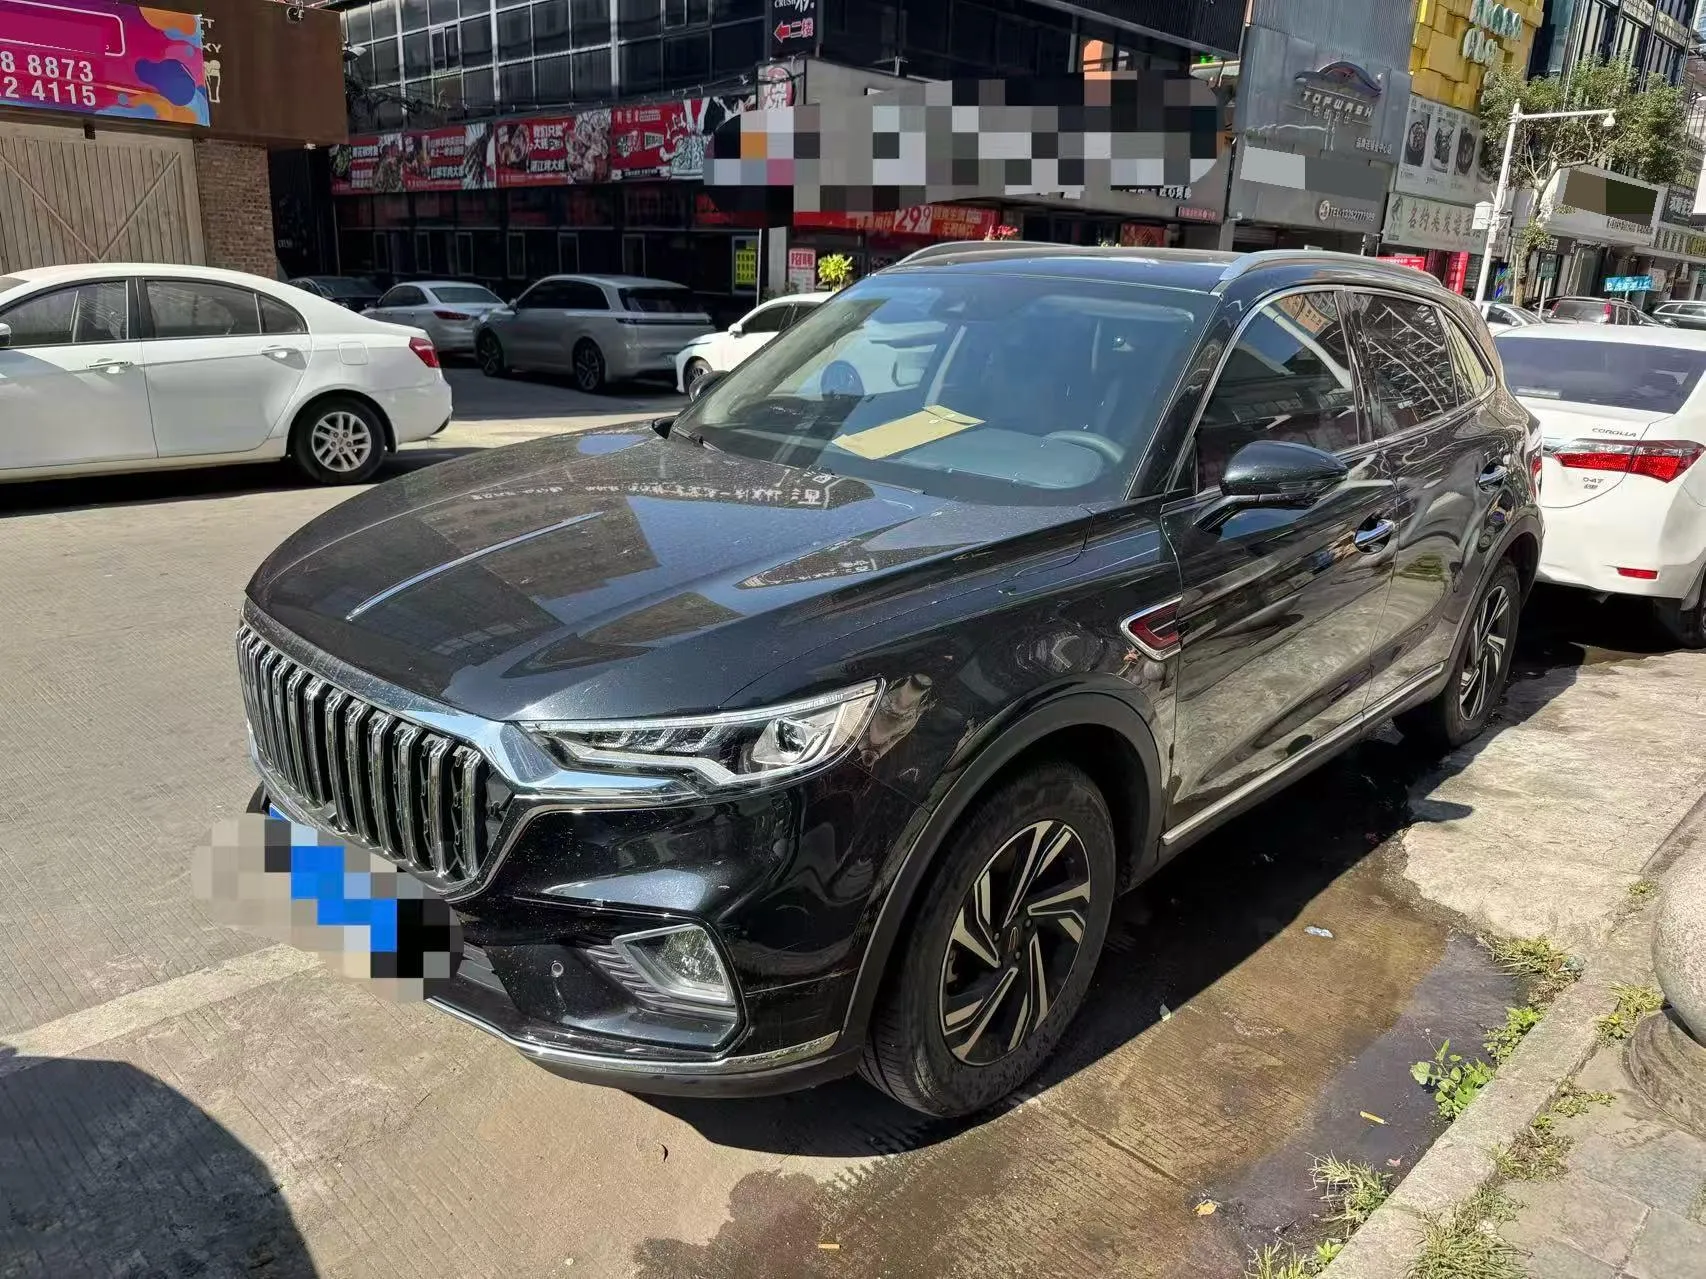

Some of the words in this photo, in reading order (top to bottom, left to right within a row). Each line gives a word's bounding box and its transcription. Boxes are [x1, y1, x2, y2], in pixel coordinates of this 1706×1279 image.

[790, 17, 814, 38] 二楼
[0, 51, 16, 73] 8
[27, 54, 94, 83] 8873
[0, 76, 20, 98] 2
[31, 79, 96, 107] 4115
[1303, 90, 1374, 118] TOPWASH
[1592, 427, 1637, 438] COROLLA
